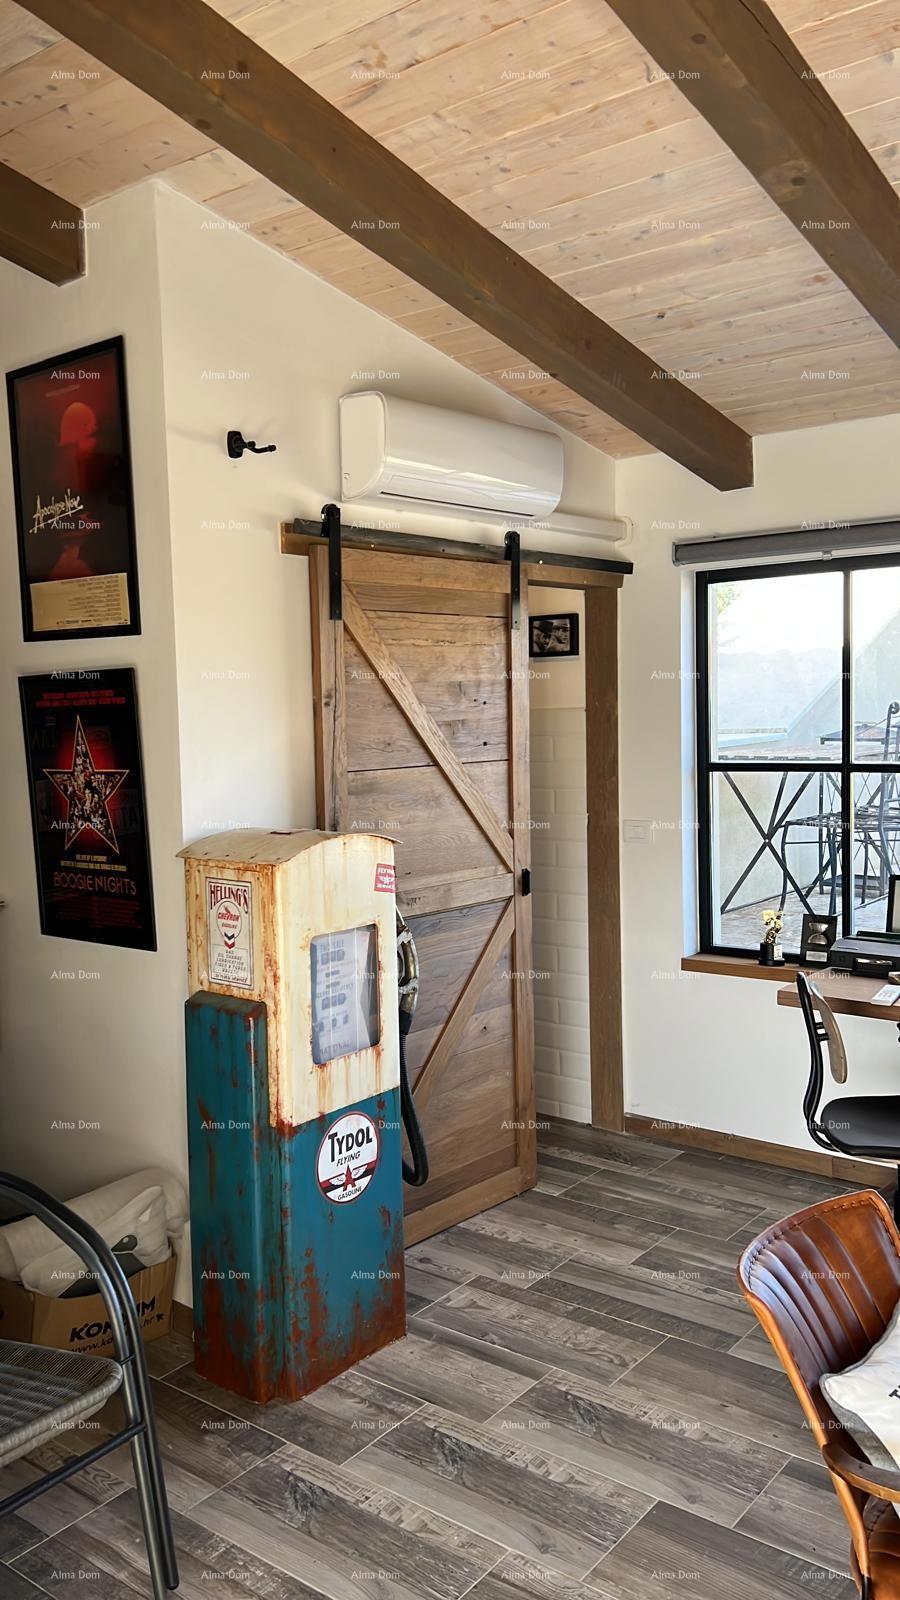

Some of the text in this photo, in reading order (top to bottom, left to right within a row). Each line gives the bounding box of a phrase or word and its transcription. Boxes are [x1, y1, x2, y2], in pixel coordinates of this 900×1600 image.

[53, 871, 137, 895] BOOGIE NIGHTS
[209, 884, 249, 914] HELLING'S
[217, 907, 241, 921] CHEVRON
[328, 1126, 373, 1162] TYDOL
[336, 1151, 361, 1167] FLYING
[337, 1186, 363, 1201] GASOLINE
